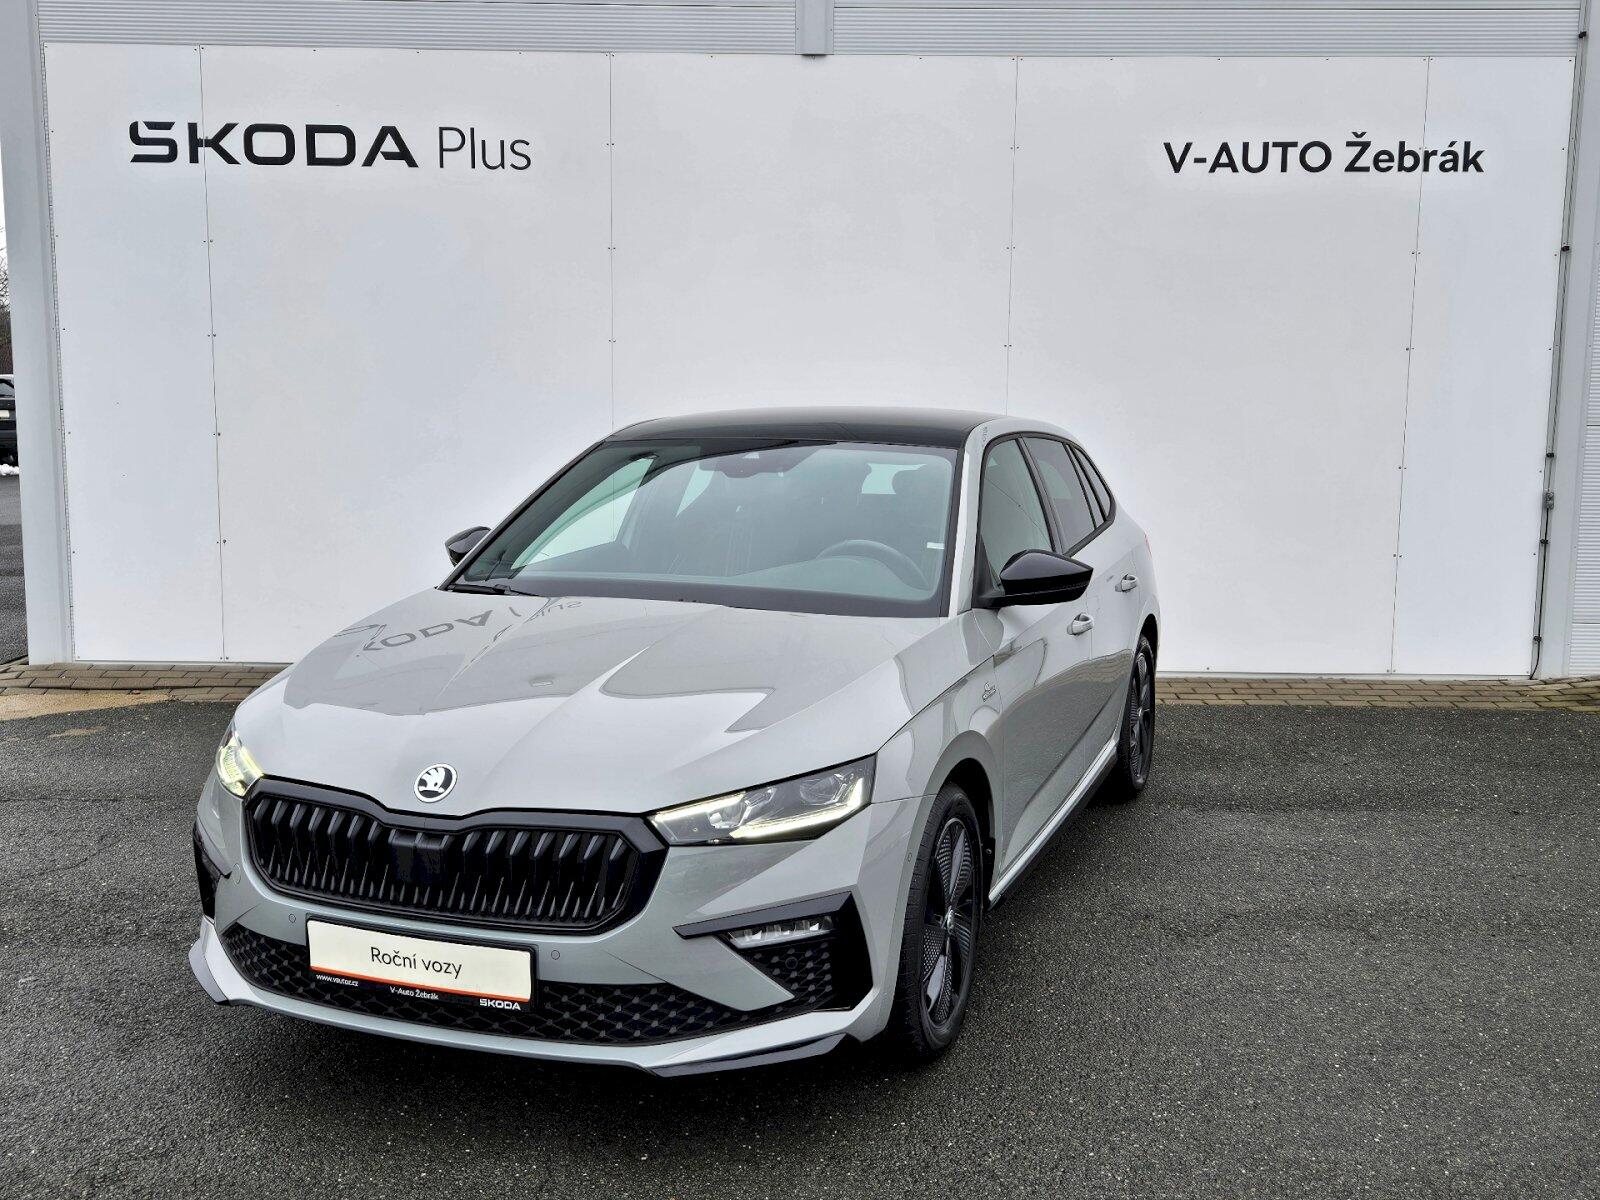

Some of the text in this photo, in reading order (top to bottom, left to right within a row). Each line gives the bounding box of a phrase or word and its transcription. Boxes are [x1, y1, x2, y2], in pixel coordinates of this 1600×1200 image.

[438, 126, 531, 170] Plus
[1163, 131, 1485, 173] V-AUTO Žebrák
[370, 946, 462, 979] Roční vozy
[389, 985, 439, 1000] V-Auto Žebrák
